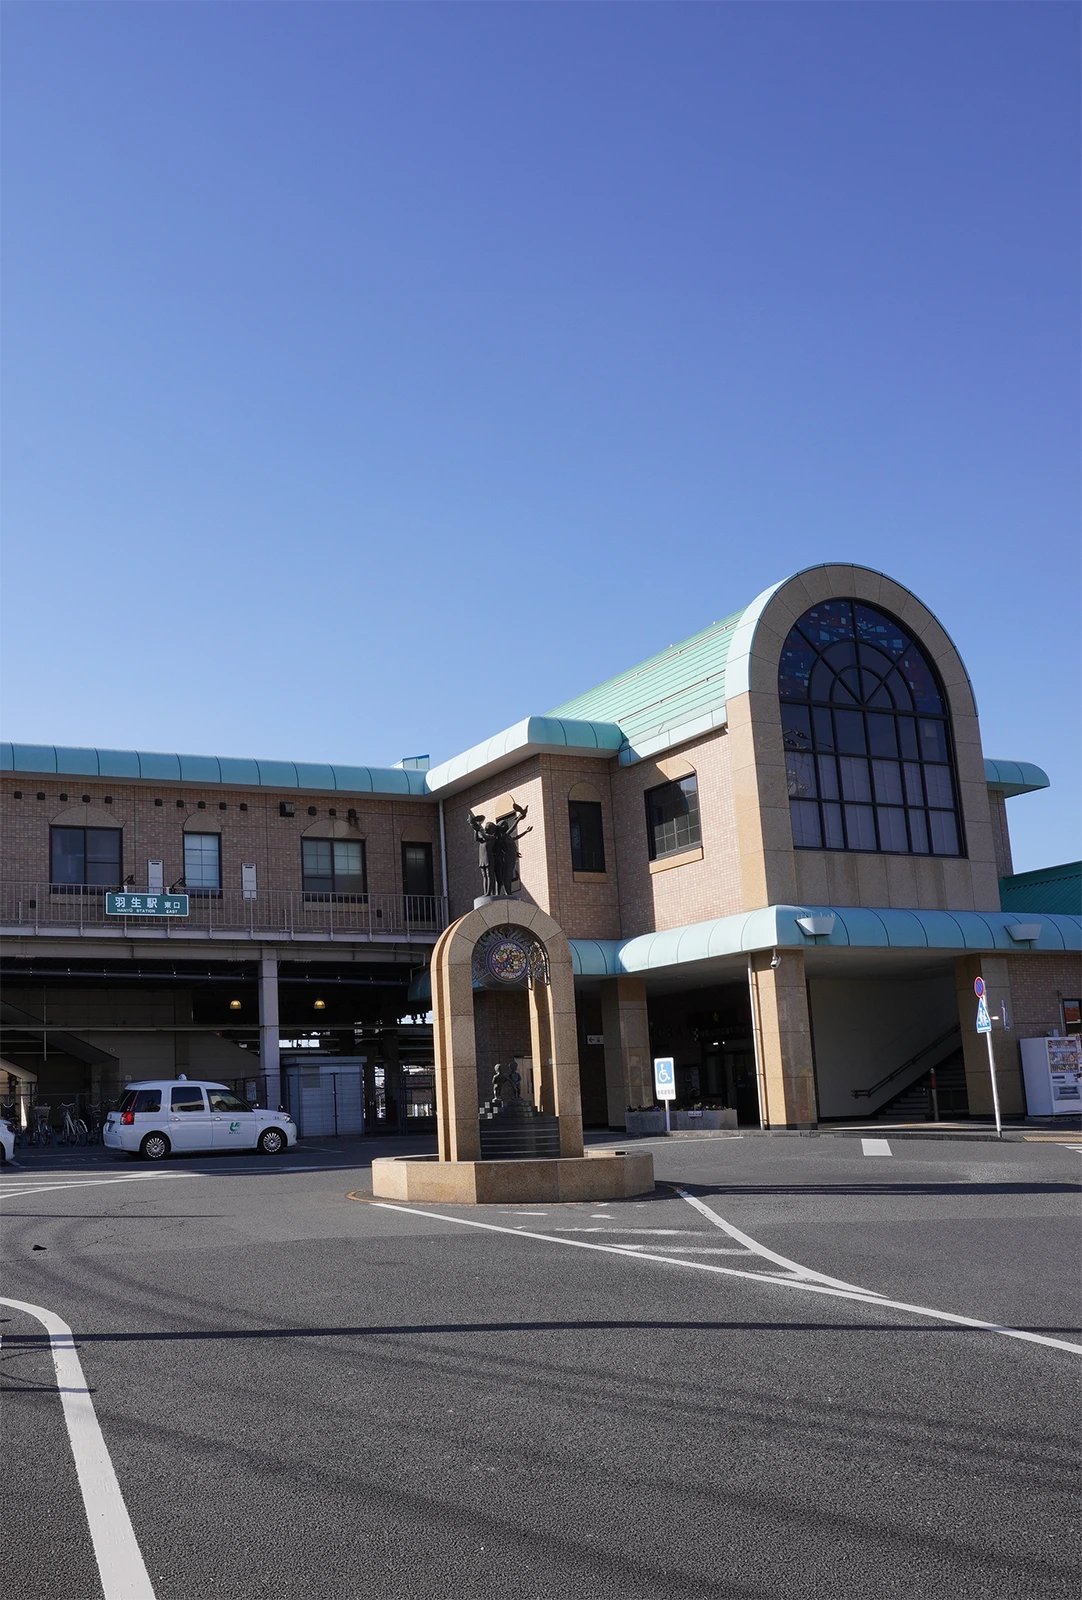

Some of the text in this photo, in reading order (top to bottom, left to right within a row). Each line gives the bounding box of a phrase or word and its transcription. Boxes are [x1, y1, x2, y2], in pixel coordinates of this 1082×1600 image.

[115, 897, 180, 909] 羽生駅 東口
